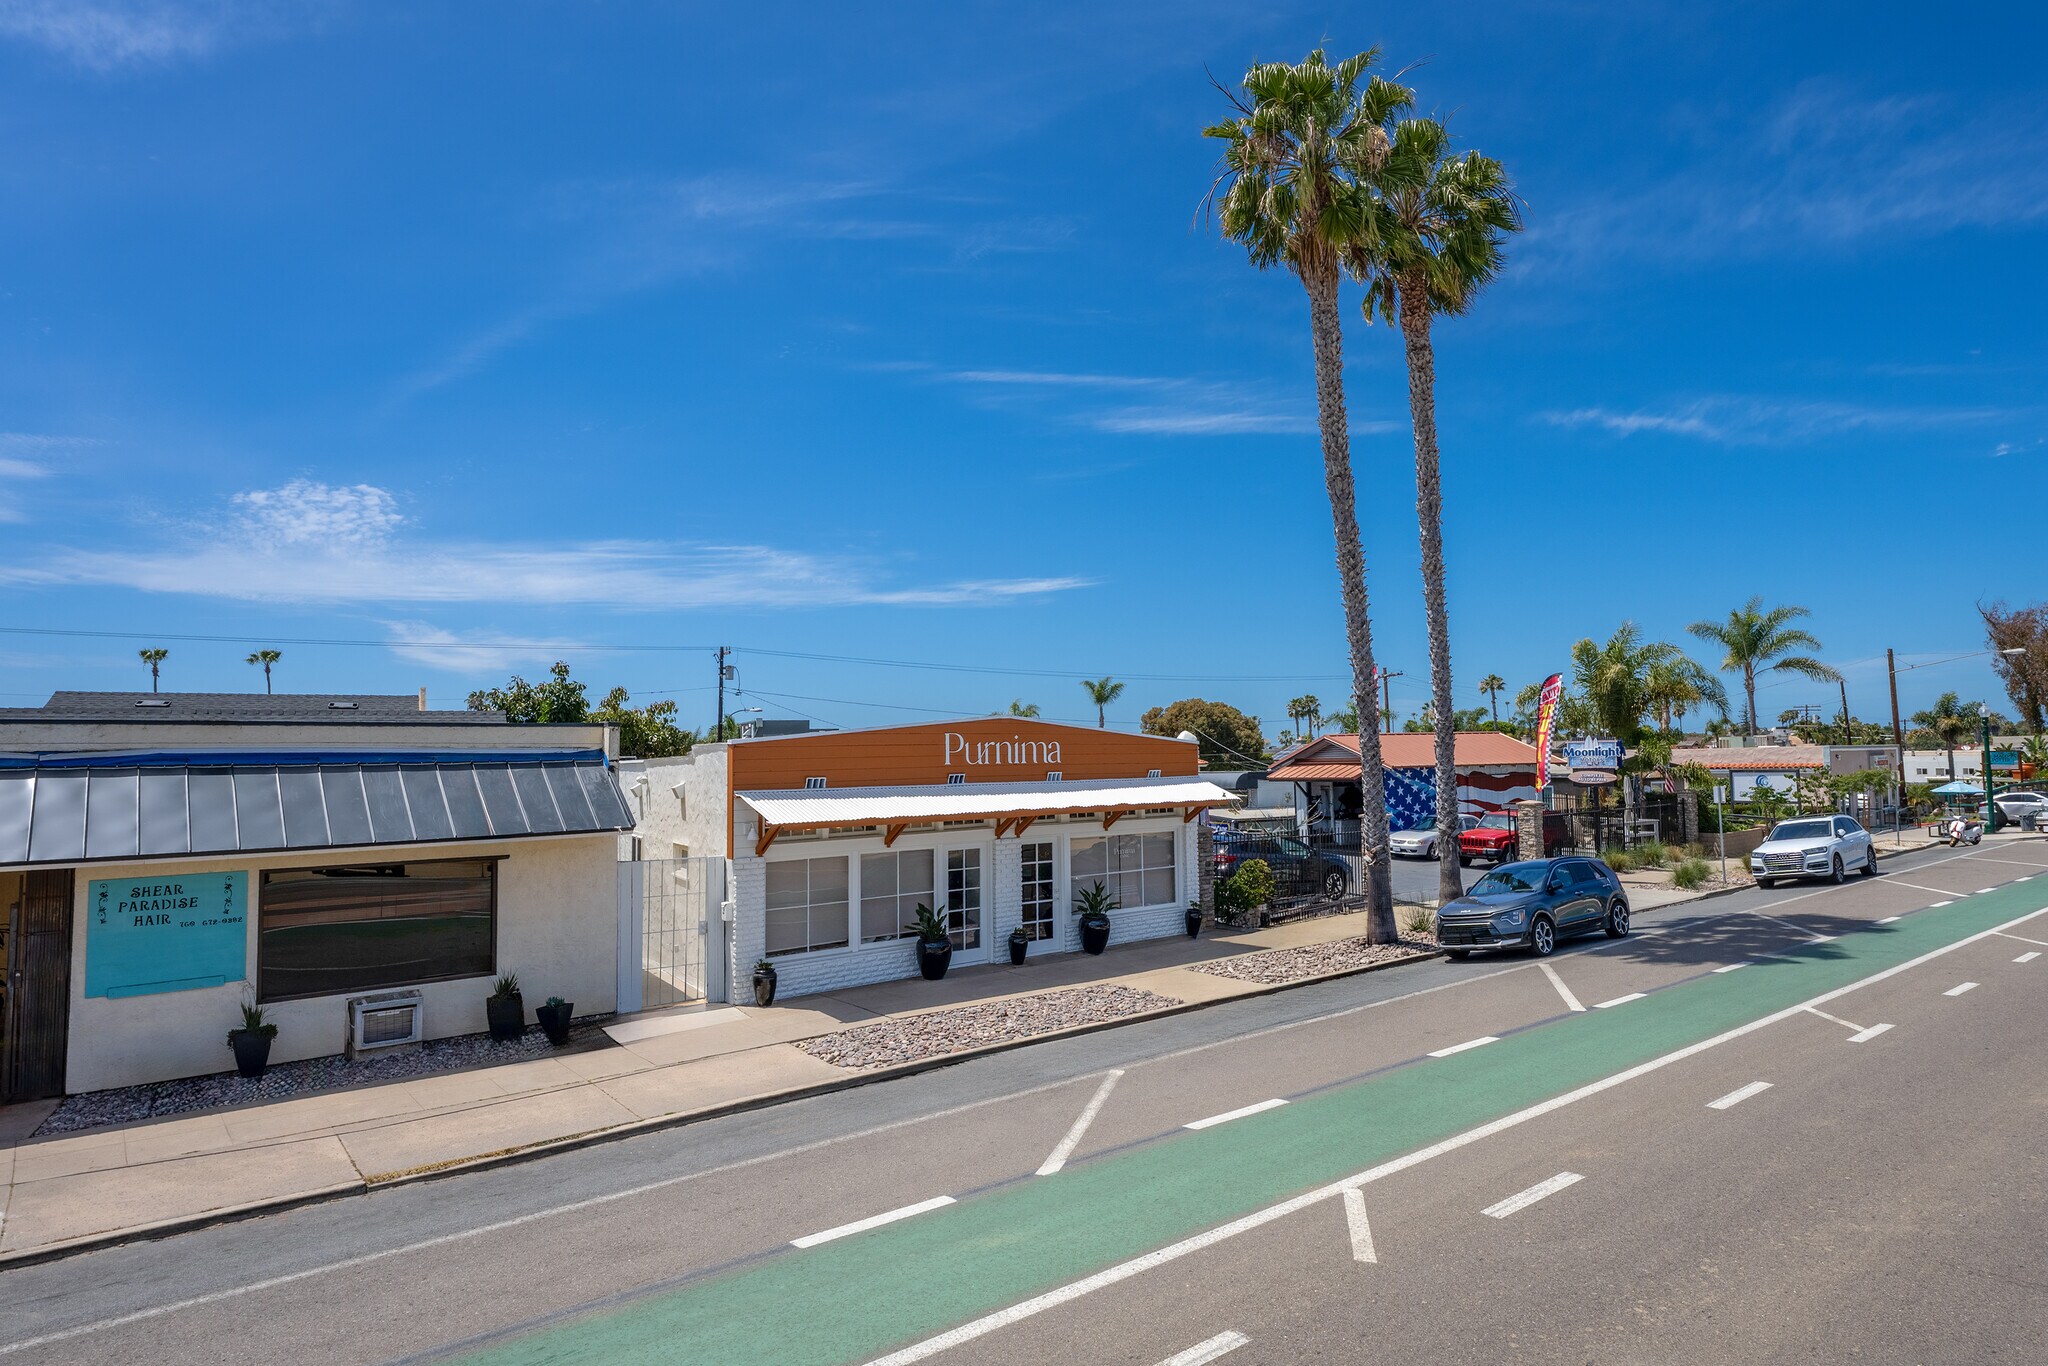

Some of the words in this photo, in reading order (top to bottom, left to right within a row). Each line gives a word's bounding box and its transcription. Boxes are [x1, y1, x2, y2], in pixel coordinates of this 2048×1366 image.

[944, 732, 1061, 765] Purnima
[1563, 746, 1621, 758] Moonlight
[131, 884, 184, 898] SHEAR
[118, 897, 199, 913] PARADISE
[133, 914, 171, 927] HAIR
[179, 920, 196, 928] 760
